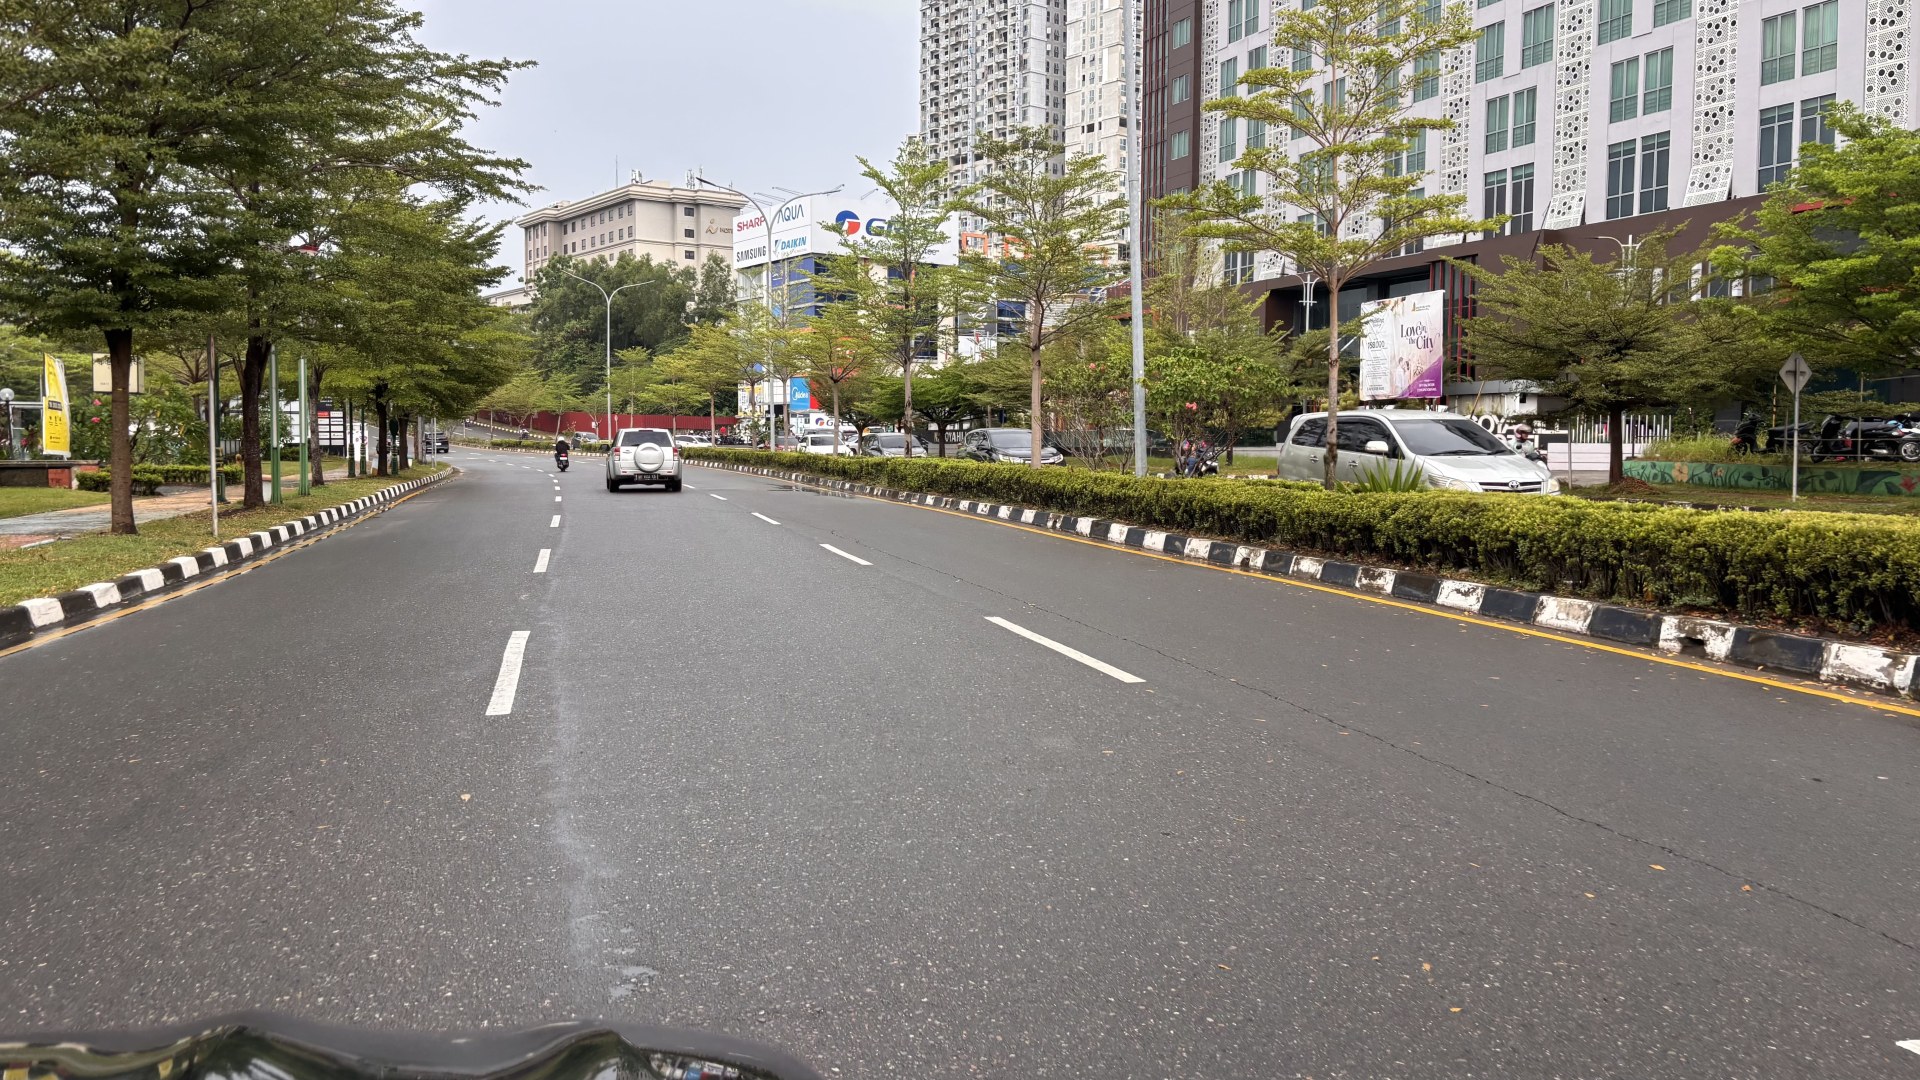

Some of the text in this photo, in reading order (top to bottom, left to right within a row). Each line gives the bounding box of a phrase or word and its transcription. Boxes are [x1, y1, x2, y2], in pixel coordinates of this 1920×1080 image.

[777, 203, 805, 224] AQUA
[736, 216, 766, 232] SHARP
[780, 235, 807, 250] DAIKIN
[736, 245, 767, 263] SAMSUNG
[1400, 322, 1423, 338] Love
[1416, 334, 1435, 352] City
